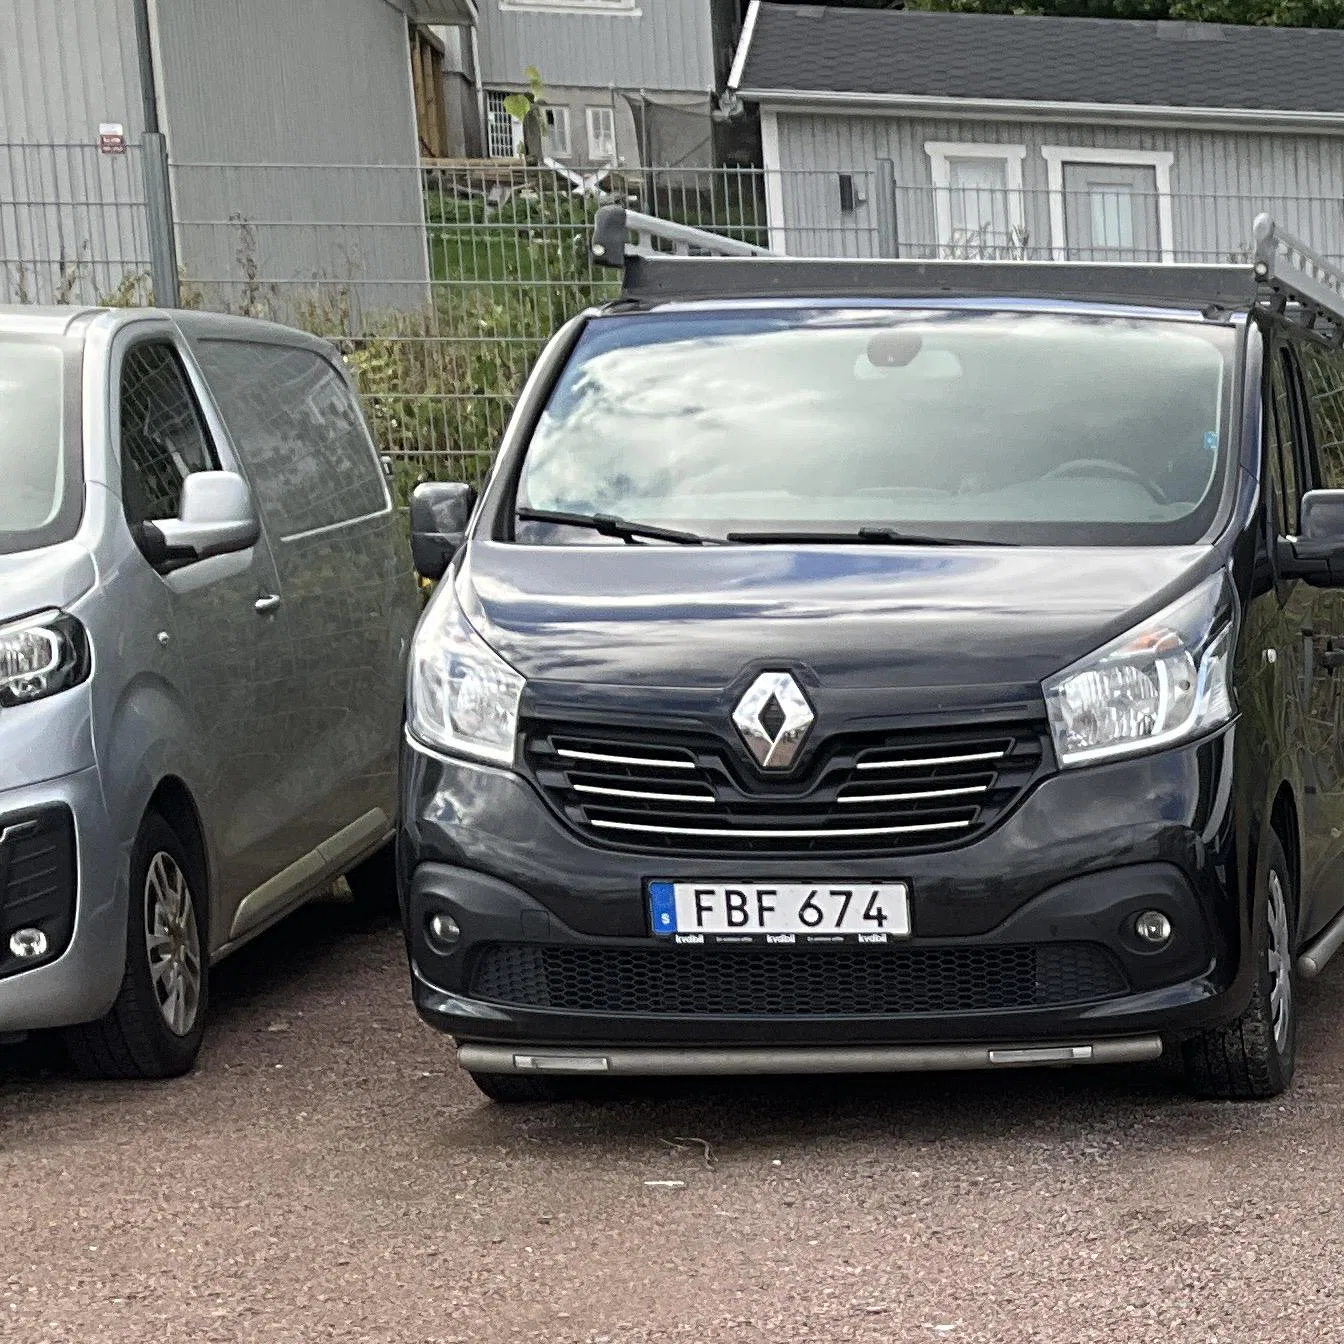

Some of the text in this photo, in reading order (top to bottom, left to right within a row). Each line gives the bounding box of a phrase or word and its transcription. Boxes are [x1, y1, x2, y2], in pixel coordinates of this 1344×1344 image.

[661, 913, 671, 924] S
[694, 889, 888, 928] FBF 674
